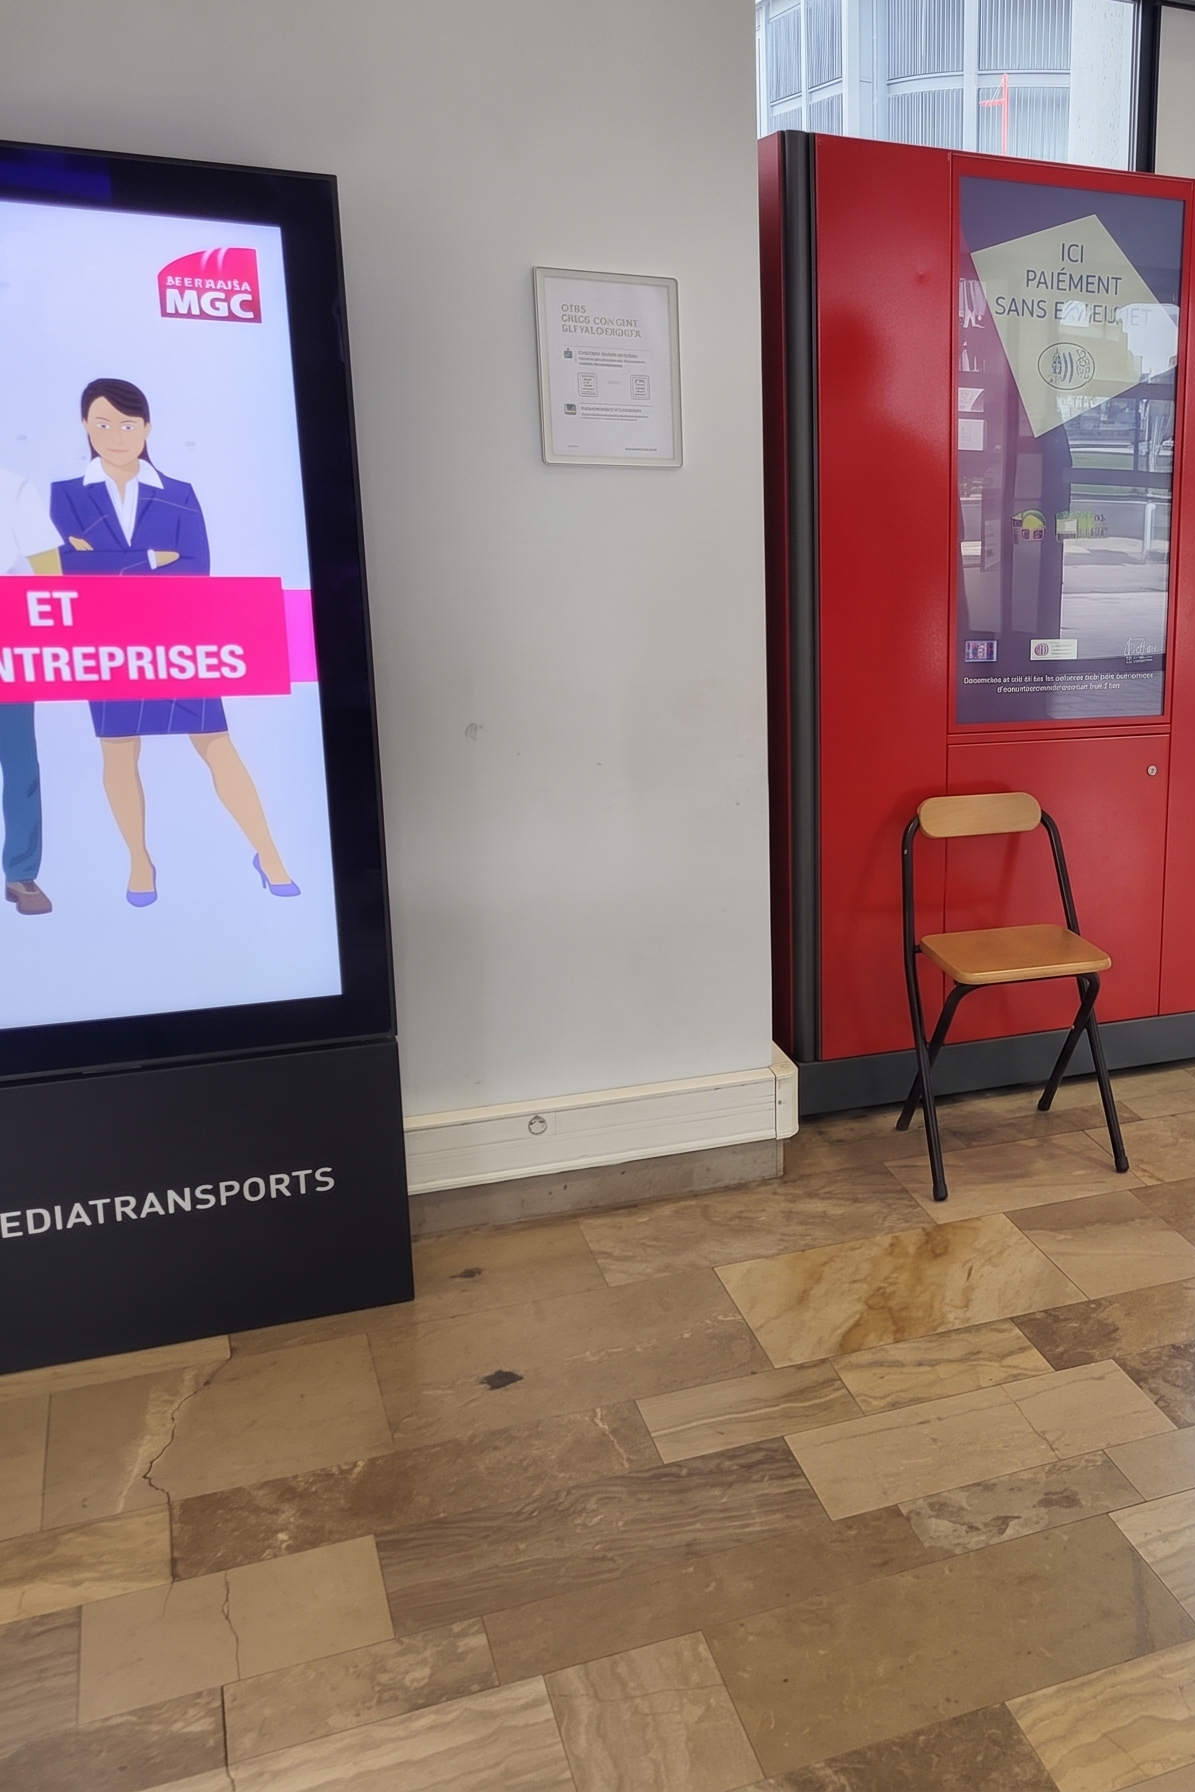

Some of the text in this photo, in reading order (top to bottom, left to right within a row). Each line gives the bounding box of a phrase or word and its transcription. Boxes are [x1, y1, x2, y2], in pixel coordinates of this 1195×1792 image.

[1061, 242, 1085, 263] ICI
[1026, 267, 1123, 296] PAIÉMENT
[166, 288, 254, 318] MGC
[994, 296, 1047, 319] SANS
[26, 590, 79, 627] ET
[0, 1166, 336, 1239] EDIATRANSPORTS
